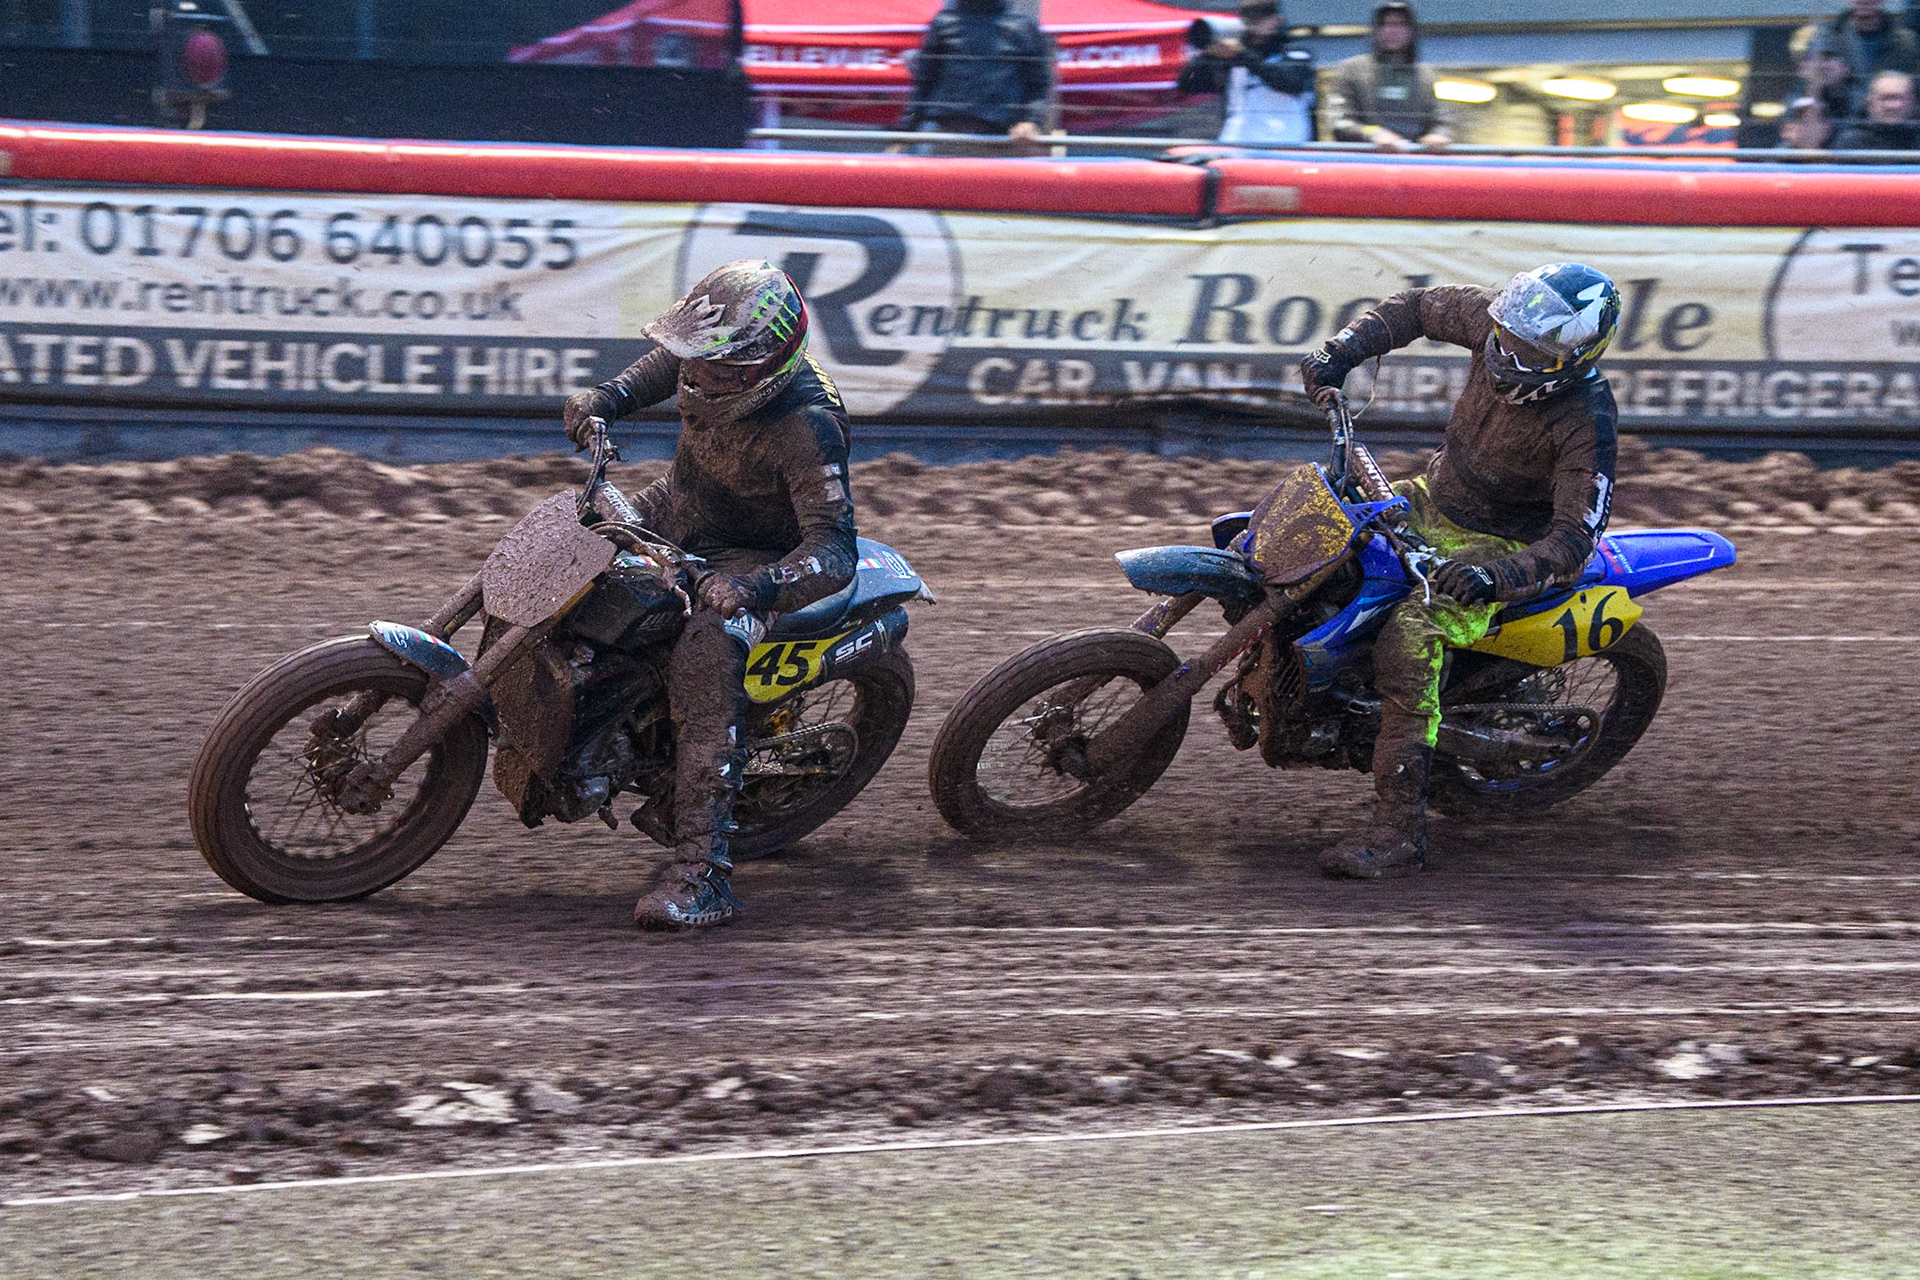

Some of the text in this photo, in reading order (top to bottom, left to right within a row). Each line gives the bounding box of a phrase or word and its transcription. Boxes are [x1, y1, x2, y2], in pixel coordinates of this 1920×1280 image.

[80, 201, 303, 262] 01706
[324, 211, 578, 270] 640055
[0, 276, 523, 321] www.rentruck.co.uk
[735, 210, 1150, 366] Rentruck
[163, 338, 443, 394] VEHICLE
[452, 346, 599, 396] HIRE
[967, 357, 1110, 405] CAR
[1351, 446, 1396, 501] RENTHA
[1552, 591, 1623, 663] 16
[746, 641, 817, 686] 45
